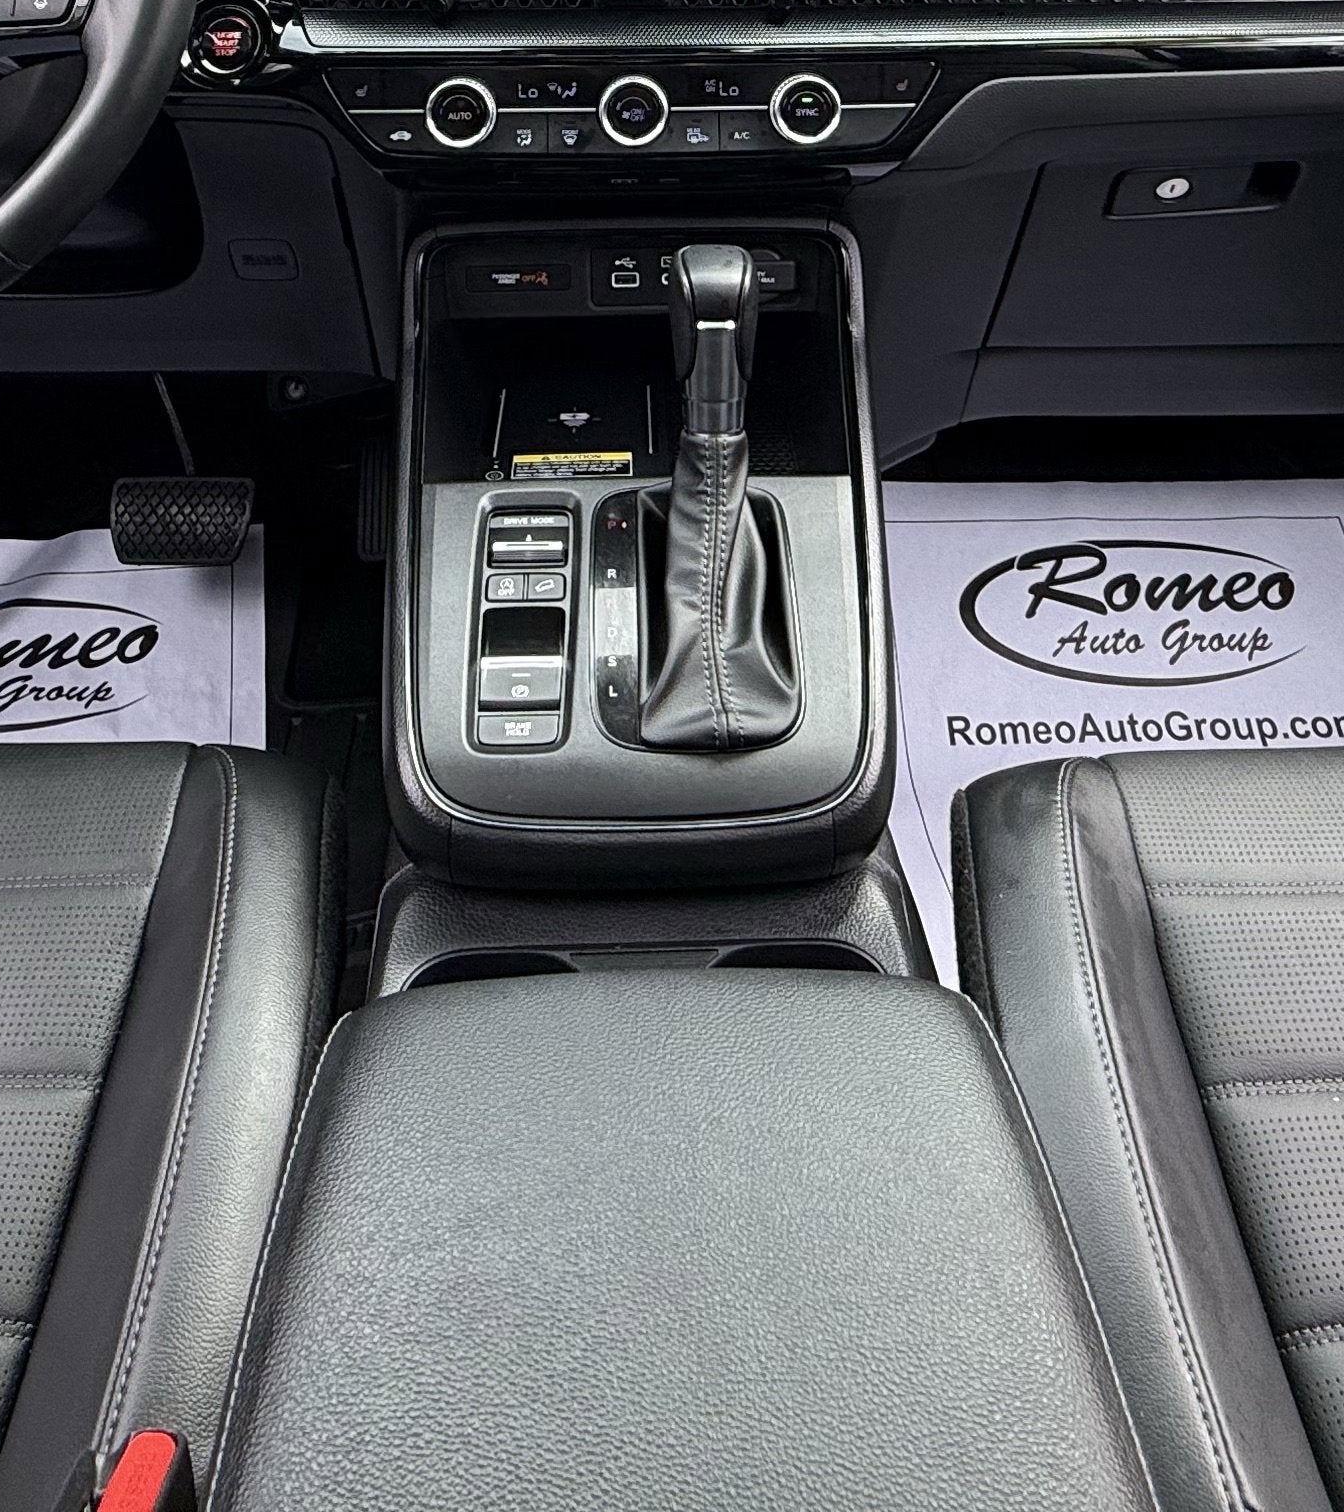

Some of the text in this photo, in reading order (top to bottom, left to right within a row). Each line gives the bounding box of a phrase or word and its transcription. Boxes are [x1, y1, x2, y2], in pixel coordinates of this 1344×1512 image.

[518, 83, 538, 98] Lo
[719, 81, 739, 96] Lo
[448, 112, 472, 120] AUTO
[796, 109, 819, 117] SYNC
[607, 521, 617, 529] P
[607, 568, 617, 579] R
[1017, 542, 1295, 619] Romeo
[607, 627, 617, 637] D
[1052, 619, 1273, 665] Auto Group
[607, 656, 618, 667] S
[608, 686, 618, 697] L
